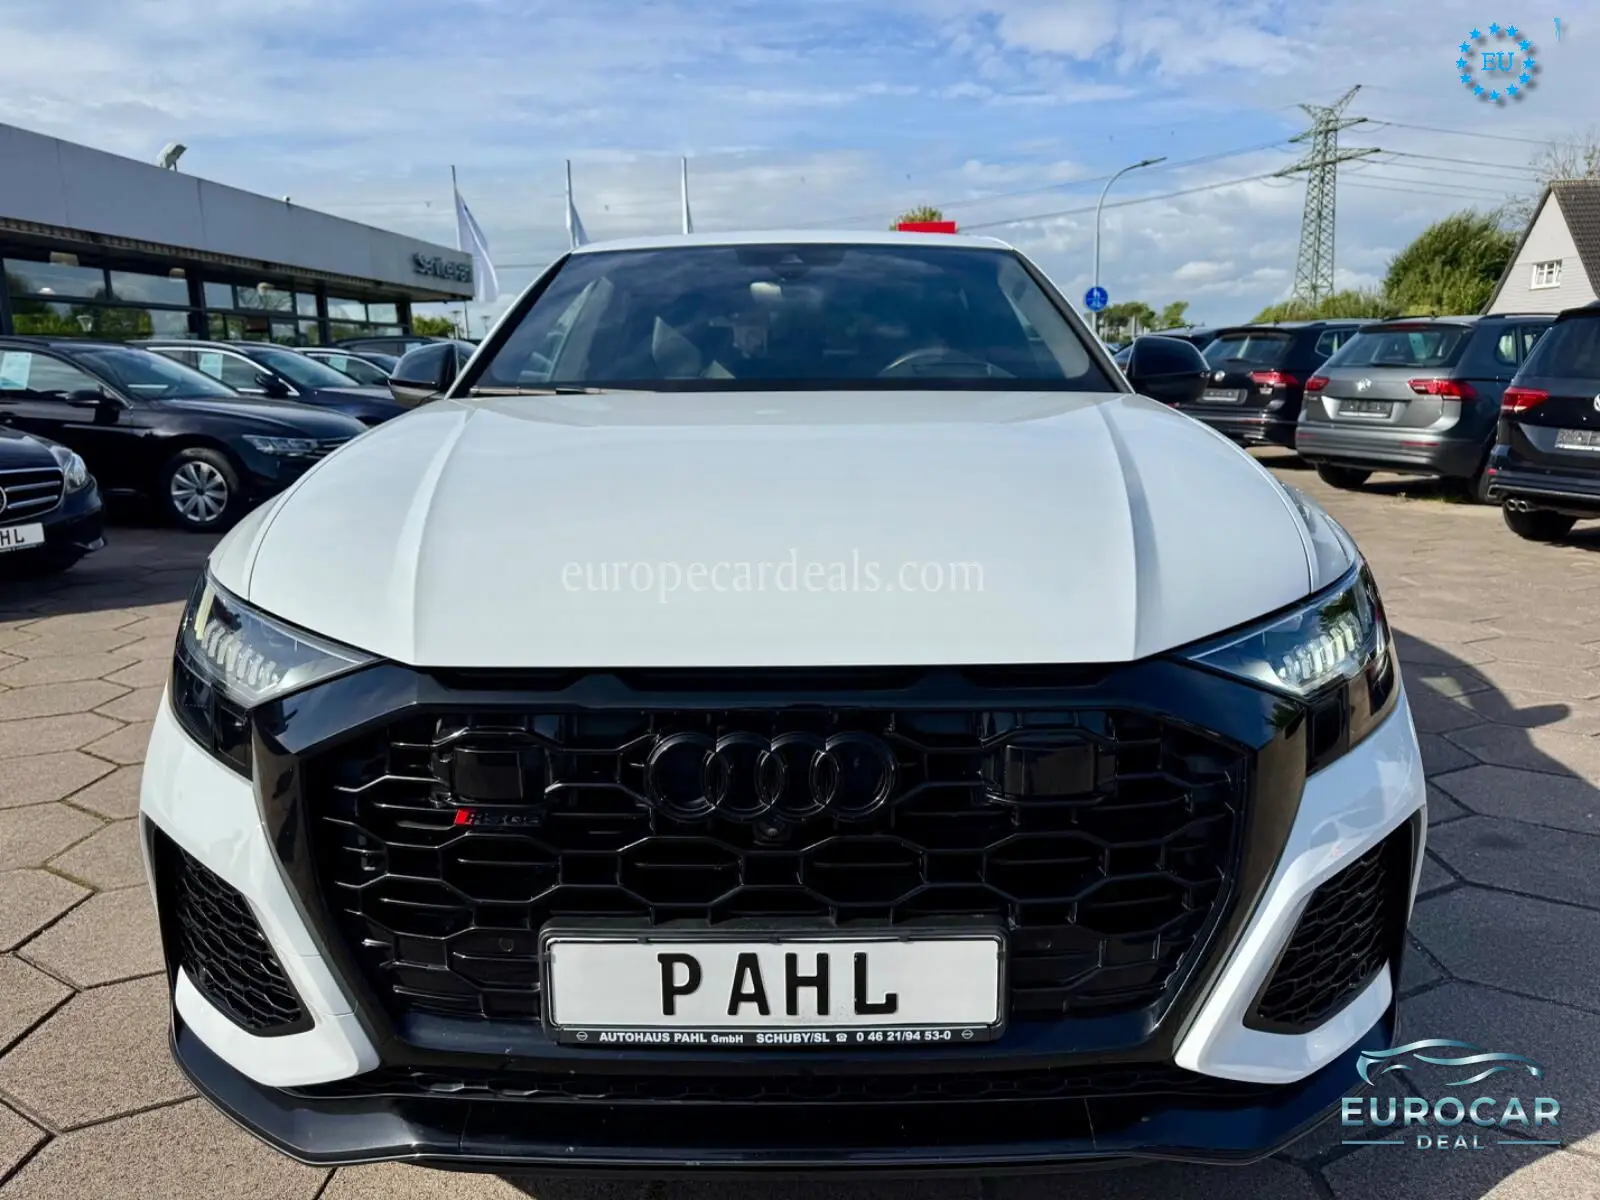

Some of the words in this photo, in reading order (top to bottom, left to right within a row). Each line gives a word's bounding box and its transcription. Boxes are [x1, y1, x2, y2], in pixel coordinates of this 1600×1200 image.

[657, 952, 898, 1016] PAHL
[599, 1032, 670, 1043] AUTOHAUS
[674, 1033, 707, 1043] PAHL
[711, 1034, 744, 1044] GmbH
[756, 1032, 830, 1044] SCHUBY/SL
[856, 1031, 864, 1042] 0
[867, 1031, 883, 1042] 46
[887, 1030, 921, 1042] 21/94
[924, 1030, 952, 1041] 53-0
